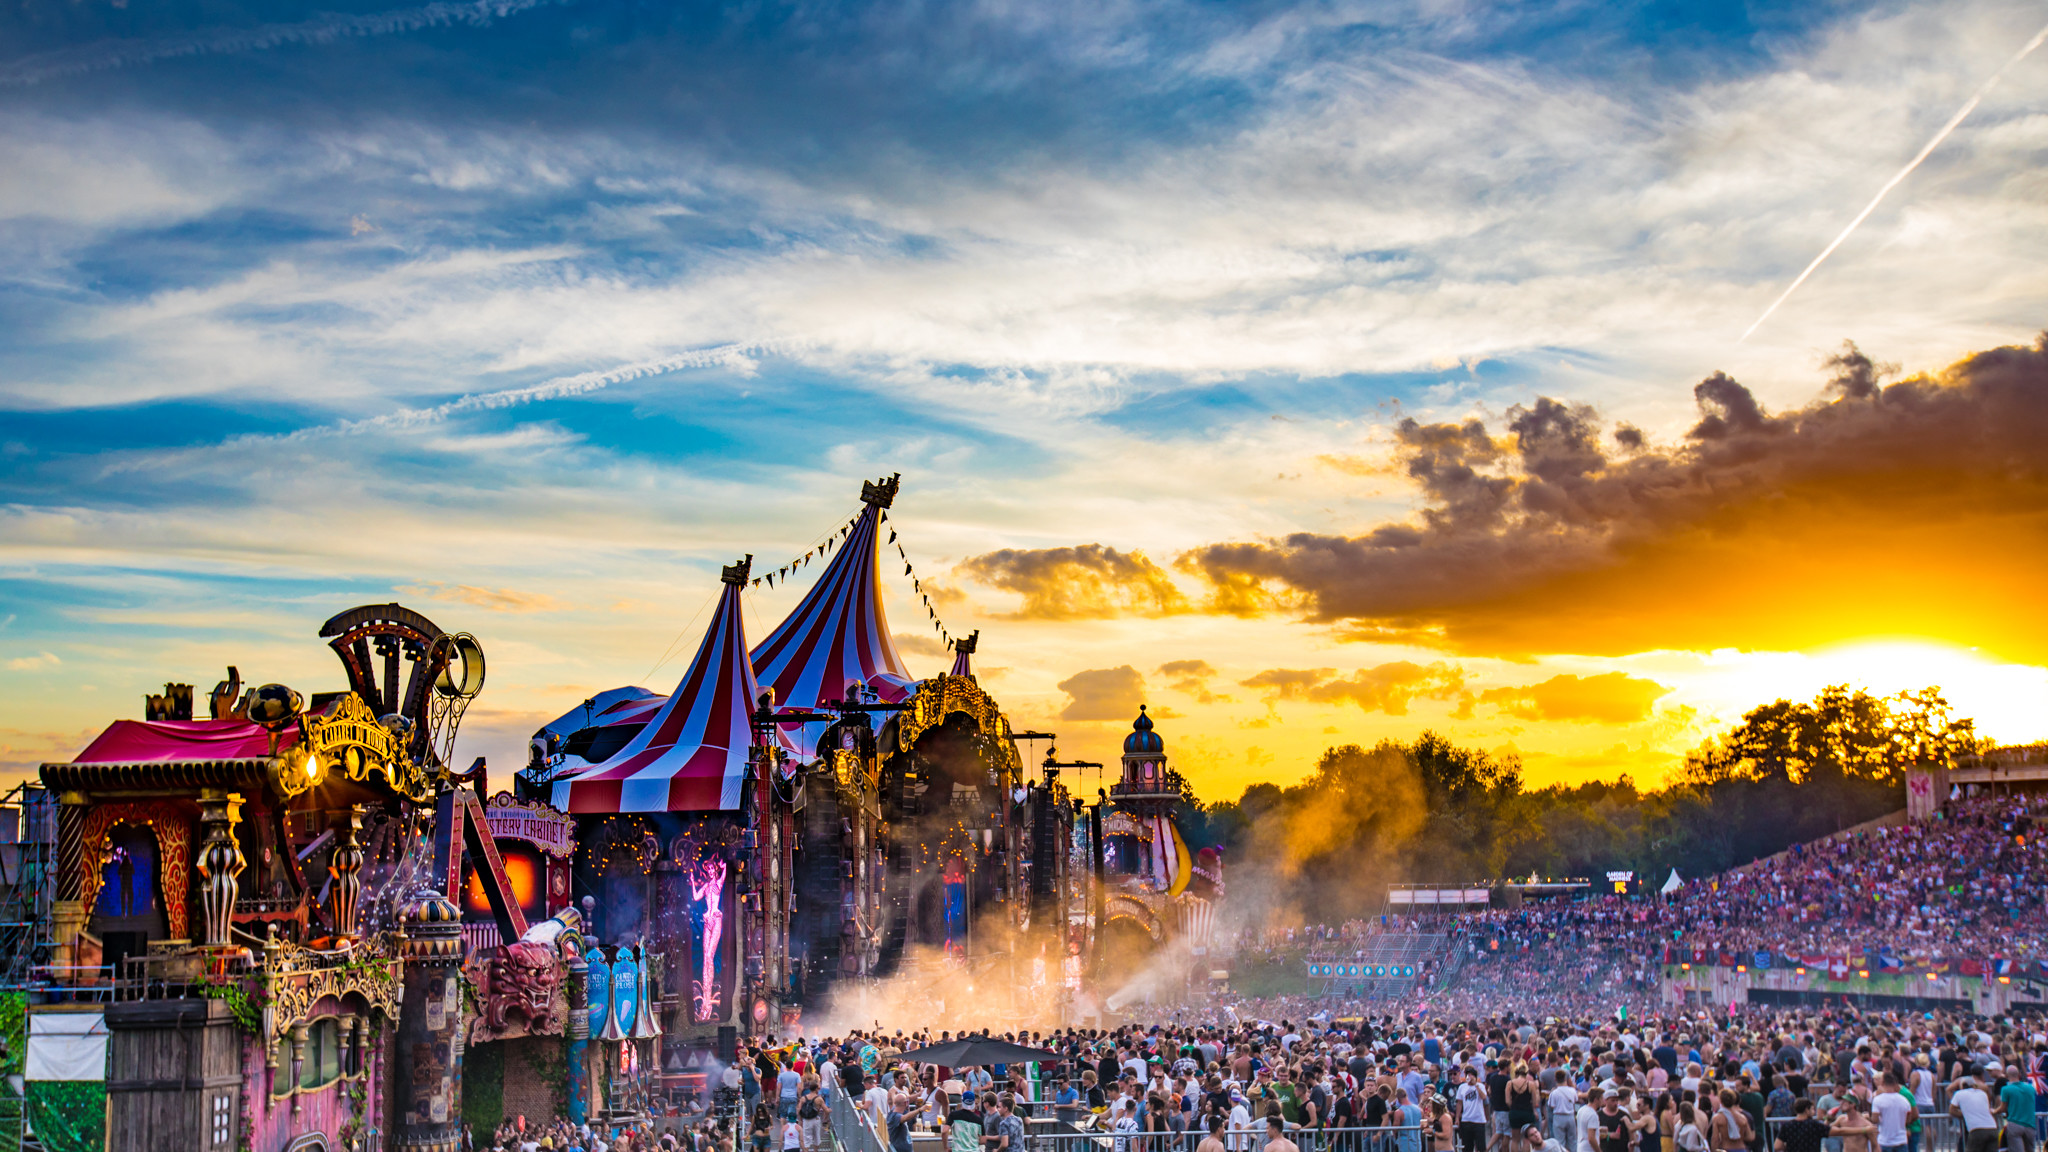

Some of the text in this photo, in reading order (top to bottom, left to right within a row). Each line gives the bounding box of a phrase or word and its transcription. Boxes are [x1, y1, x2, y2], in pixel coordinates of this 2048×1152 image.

[325, 724, 388, 756] CABARET DU MONDE
[486, 819, 565, 844] STERY CABINET
[587, 973, 607, 983] ANDY
[615, 972, 636, 983] CANDY
